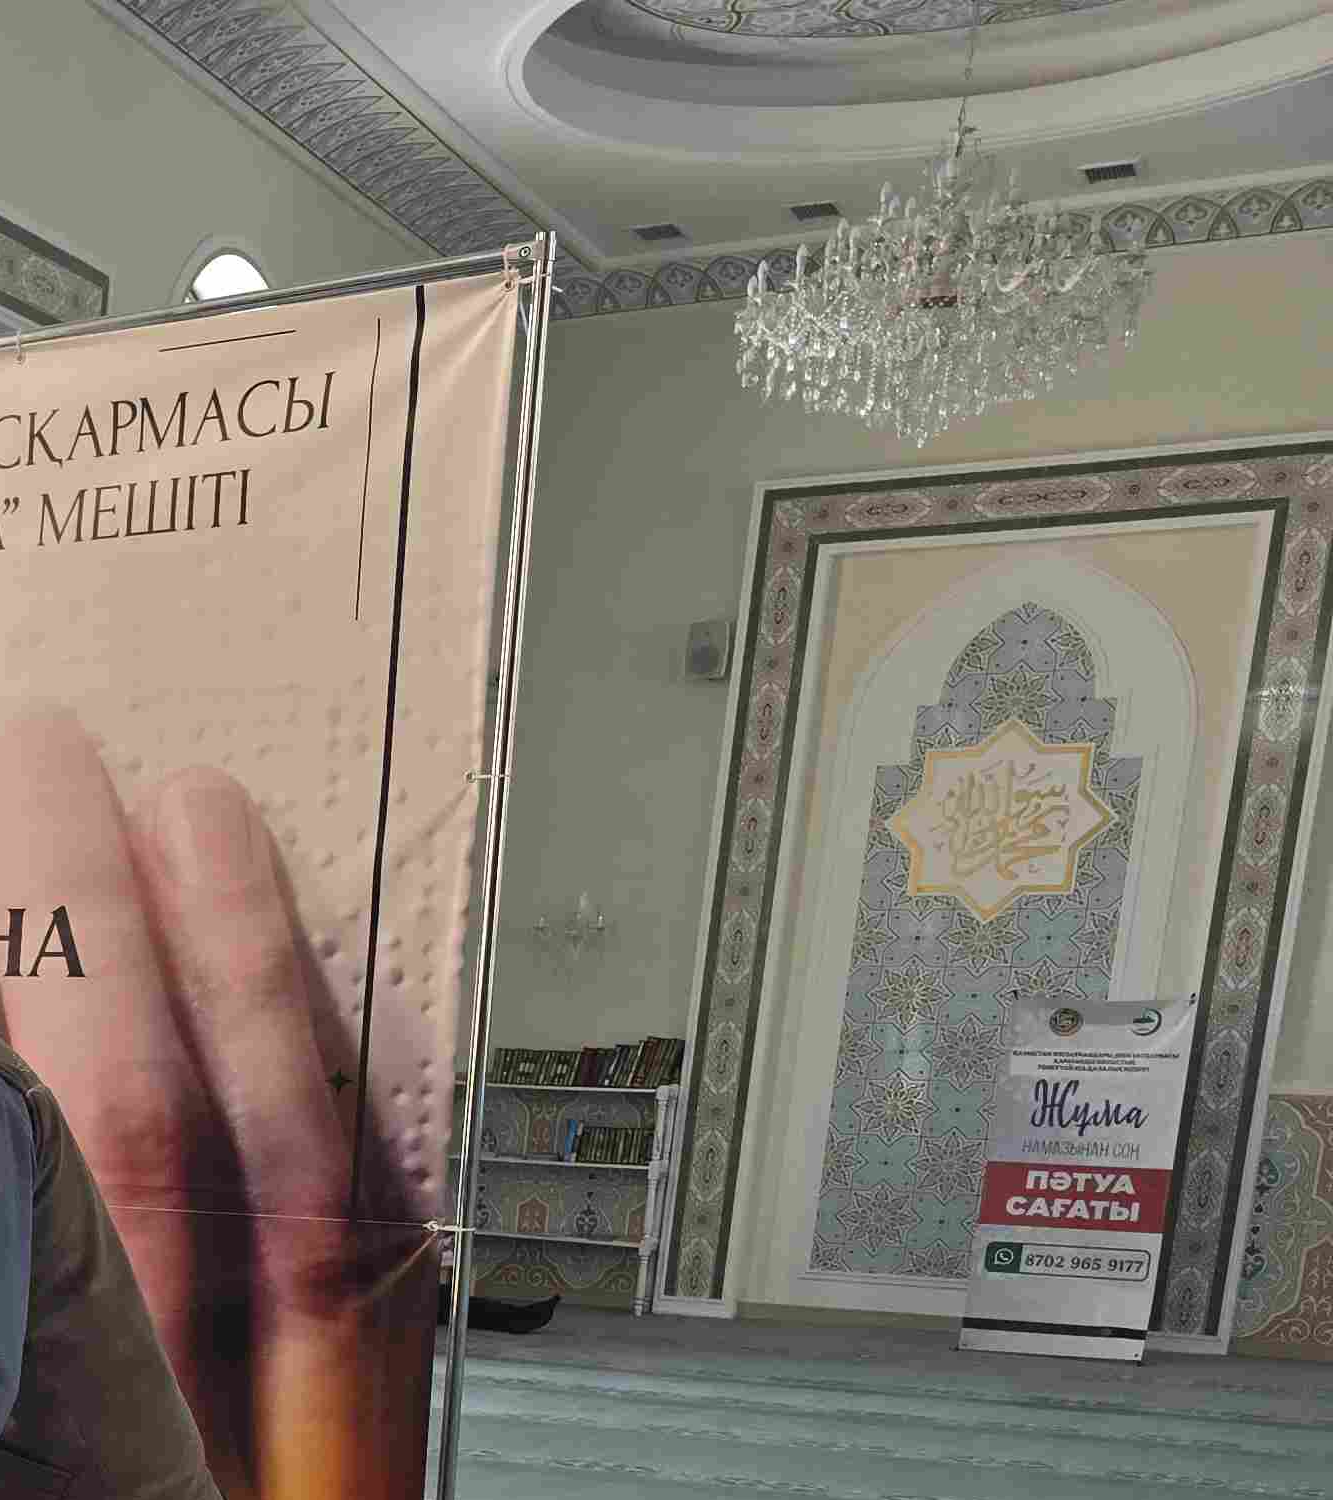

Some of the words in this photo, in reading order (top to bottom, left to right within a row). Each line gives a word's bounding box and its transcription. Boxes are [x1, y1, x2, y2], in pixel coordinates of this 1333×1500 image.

[37, 469, 252, 547] МЕШІТІ
[1025, 1170, 1135, 1195] ПӘТУА
[1006, 1196, 1140, 1222] САҒАТЫ
[1027, 1254, 1064, 1269] 8702
[1070, 1257, 1102, 1271] 965
[1109, 1258, 1143, 1273] 9177
